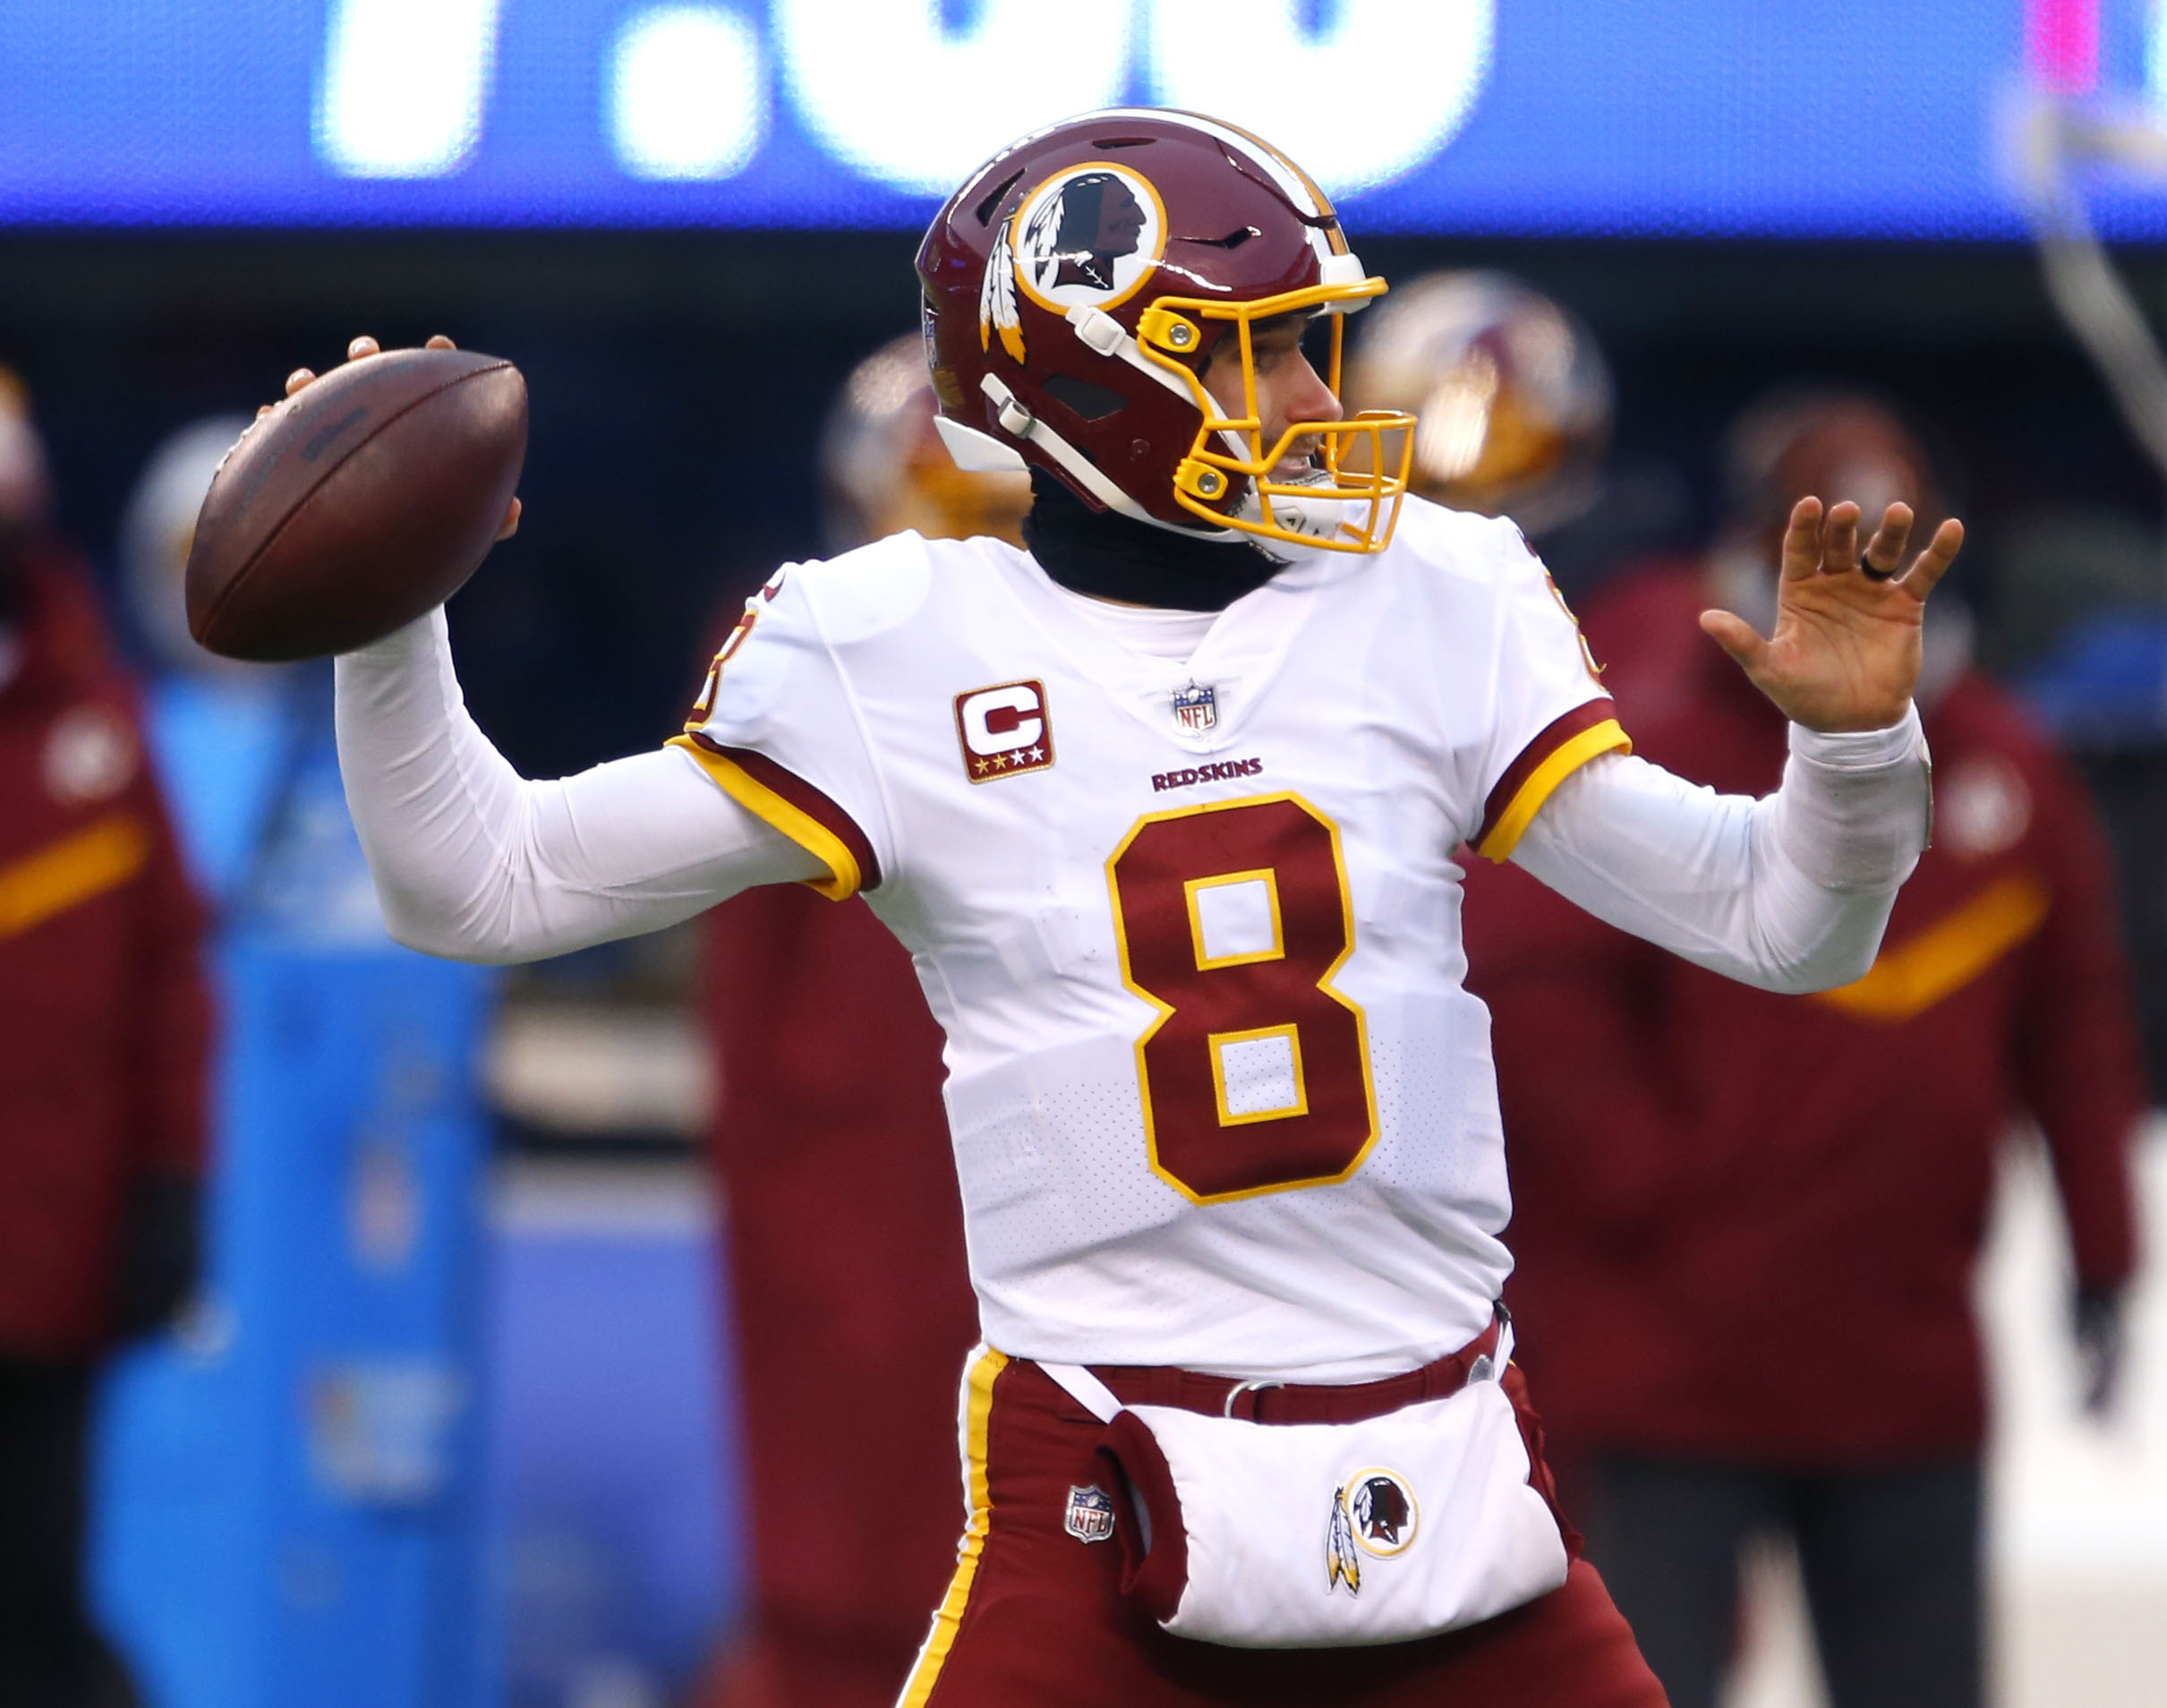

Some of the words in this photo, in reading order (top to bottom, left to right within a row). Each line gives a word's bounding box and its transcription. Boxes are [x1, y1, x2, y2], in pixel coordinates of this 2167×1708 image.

[962, 686, 1043, 756] C
[1179, 705, 1214, 729] NFL
[1151, 757, 1263, 792] REDSKINS
[1104, 790, 1381, 1208] 8
[1073, 1508, 1106, 1533] NFL
